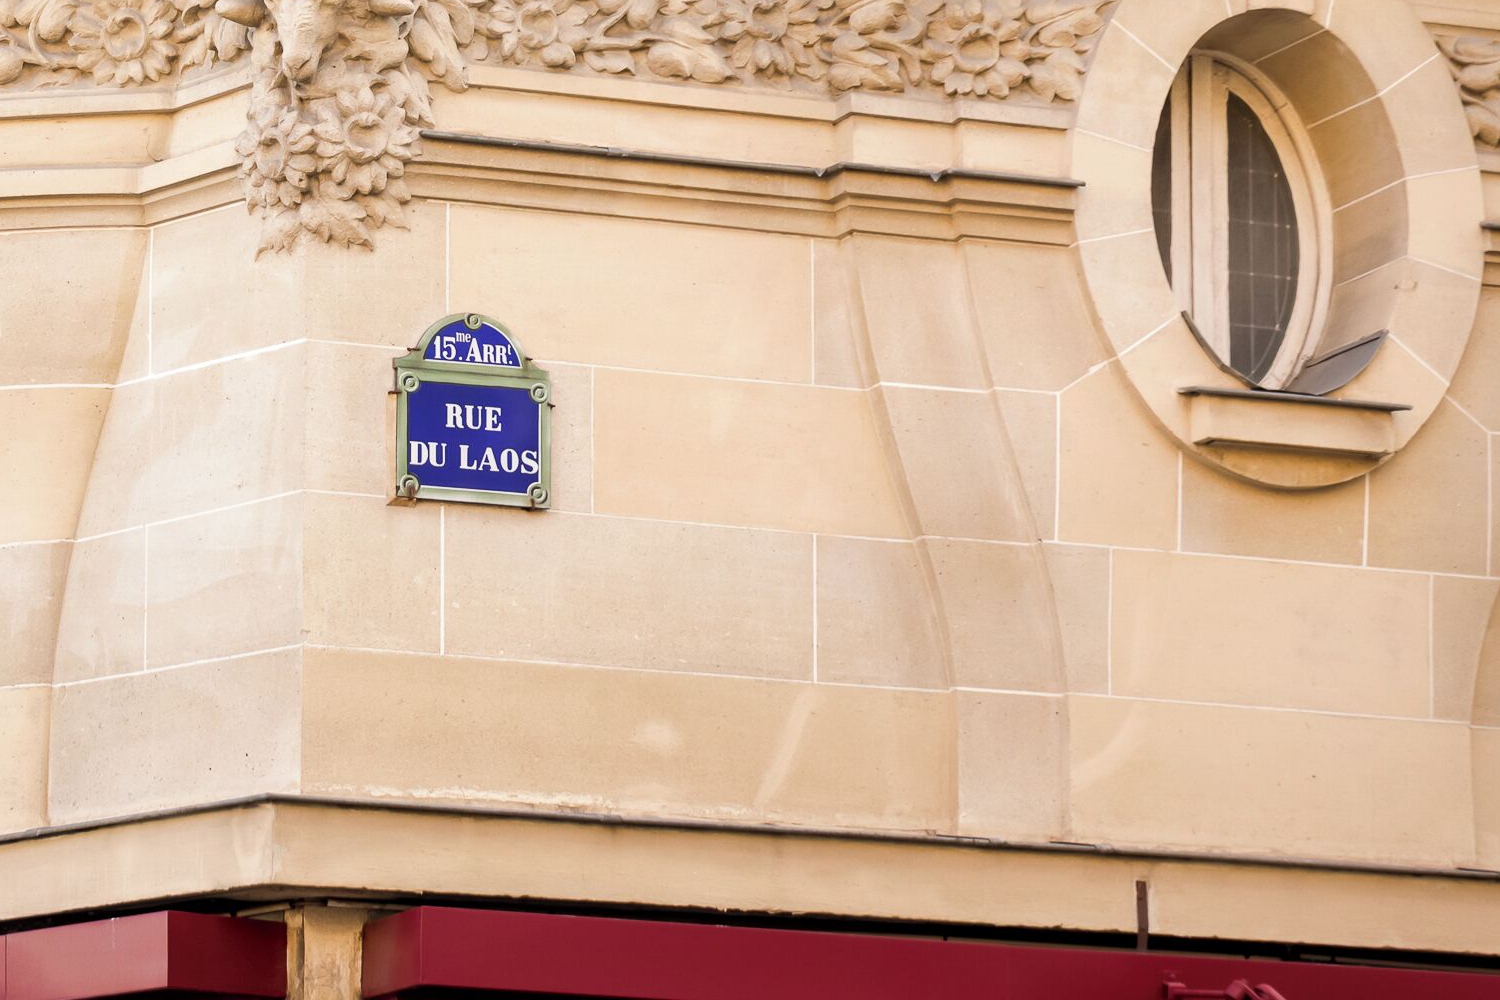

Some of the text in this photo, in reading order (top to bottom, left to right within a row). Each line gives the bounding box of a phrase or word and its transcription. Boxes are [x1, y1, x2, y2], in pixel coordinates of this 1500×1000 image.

[445, 403, 502, 432] RUE
[409, 440, 539, 475] DU LAOS
